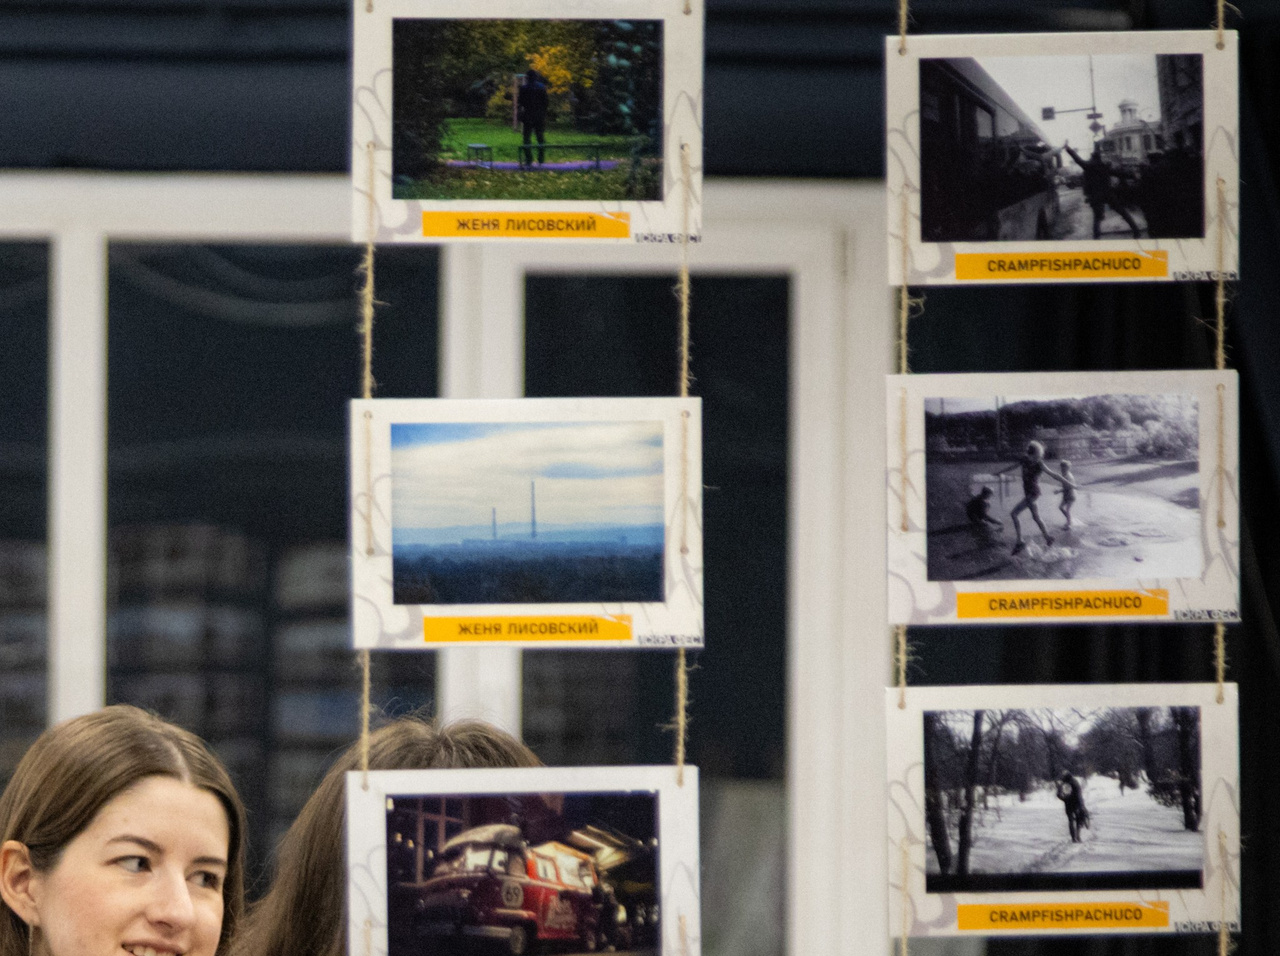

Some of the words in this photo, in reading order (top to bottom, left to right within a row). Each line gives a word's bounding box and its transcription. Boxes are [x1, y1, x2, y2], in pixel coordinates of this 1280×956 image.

[457, 219, 500, 231] ЖЕНЯ
[505, 216, 596, 231] ЛИСОВСКИЙ
[988, 257, 1141, 272] CRAMPFISHPACHUCO
[989, 596, 1142, 611] CRAMPFISHPACHUCO
[458, 623, 502, 636] ЖЕНЯ
[507, 619, 599, 635] ЛИСОВСКИЙ
[989, 908, 1143, 923] CRAMPFISHPACHUCO
